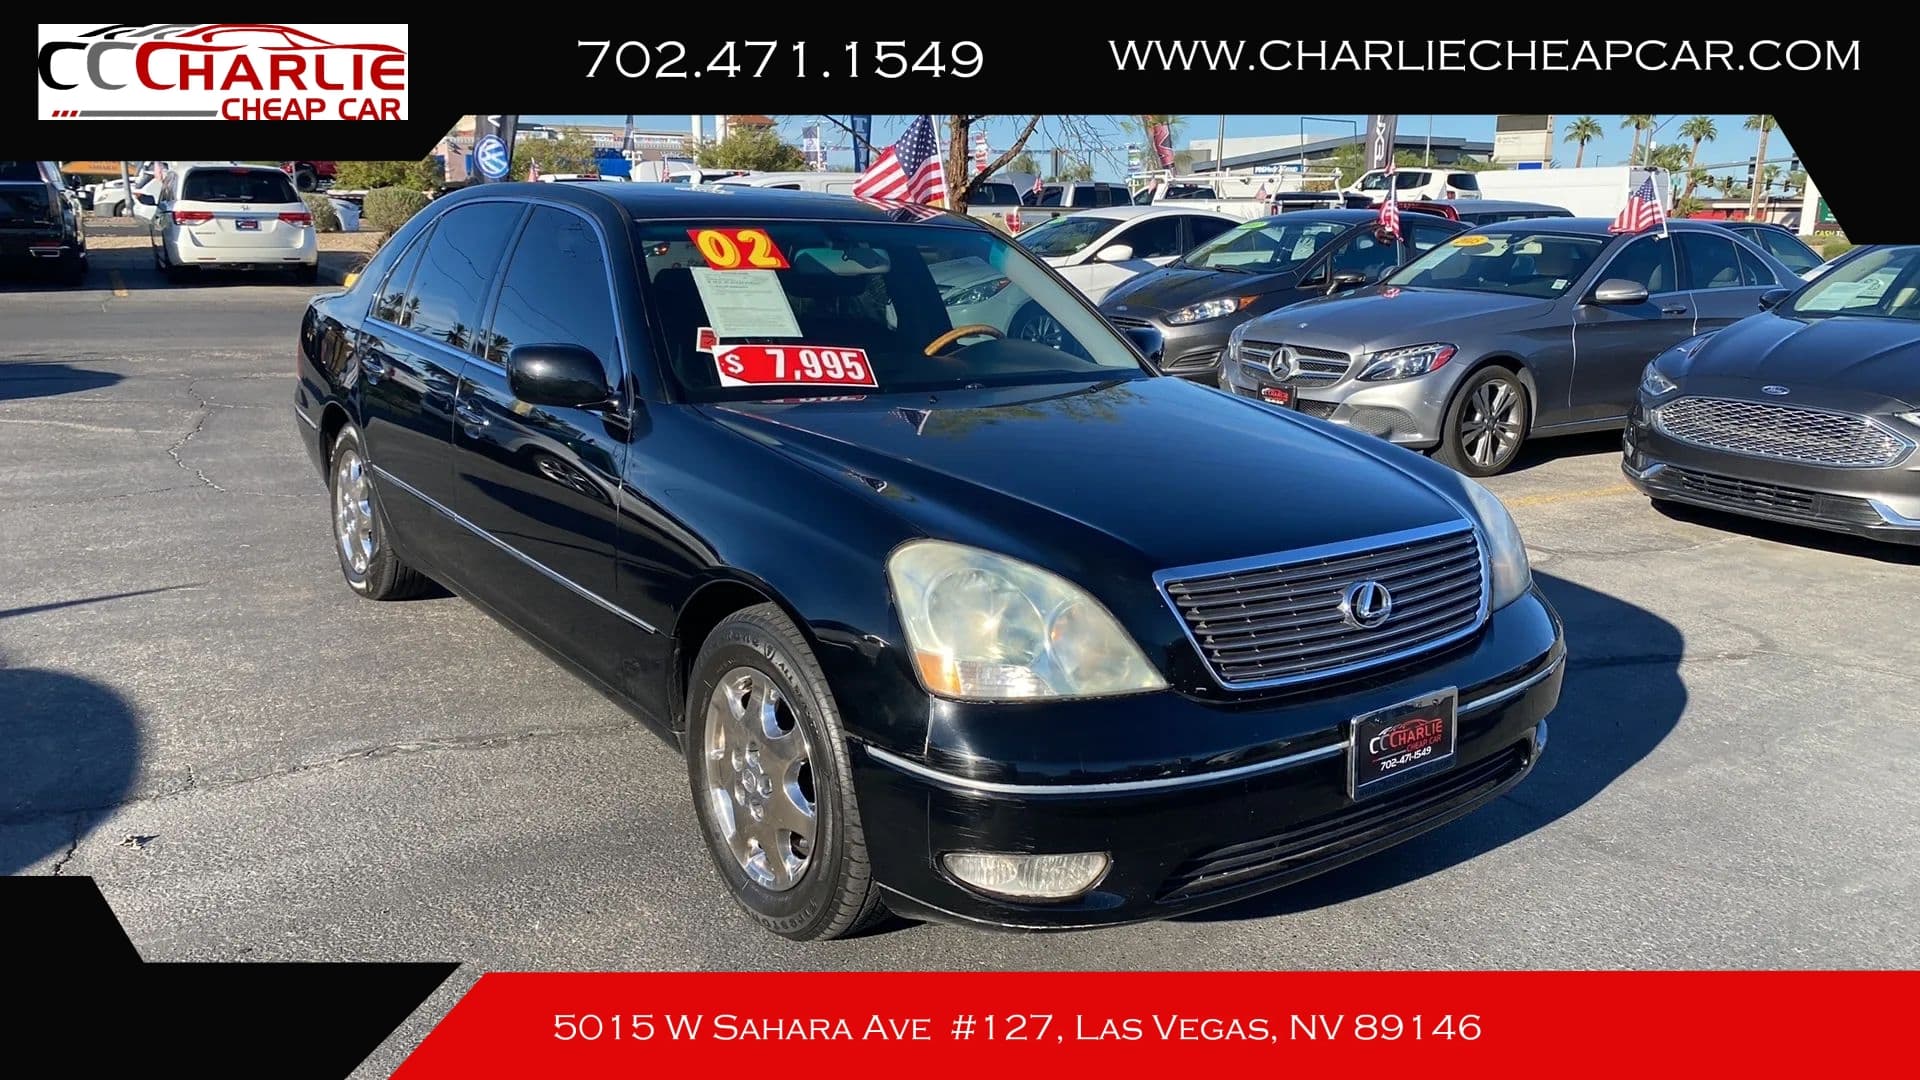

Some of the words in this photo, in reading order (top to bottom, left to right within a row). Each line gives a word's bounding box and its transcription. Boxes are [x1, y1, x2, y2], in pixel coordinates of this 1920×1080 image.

[696, 229, 782, 268] 02
[724, 354, 744, 374] $
[765, 348, 866, 381] 7,995
[1381, 746, 1432, 771] 702-471-1549
